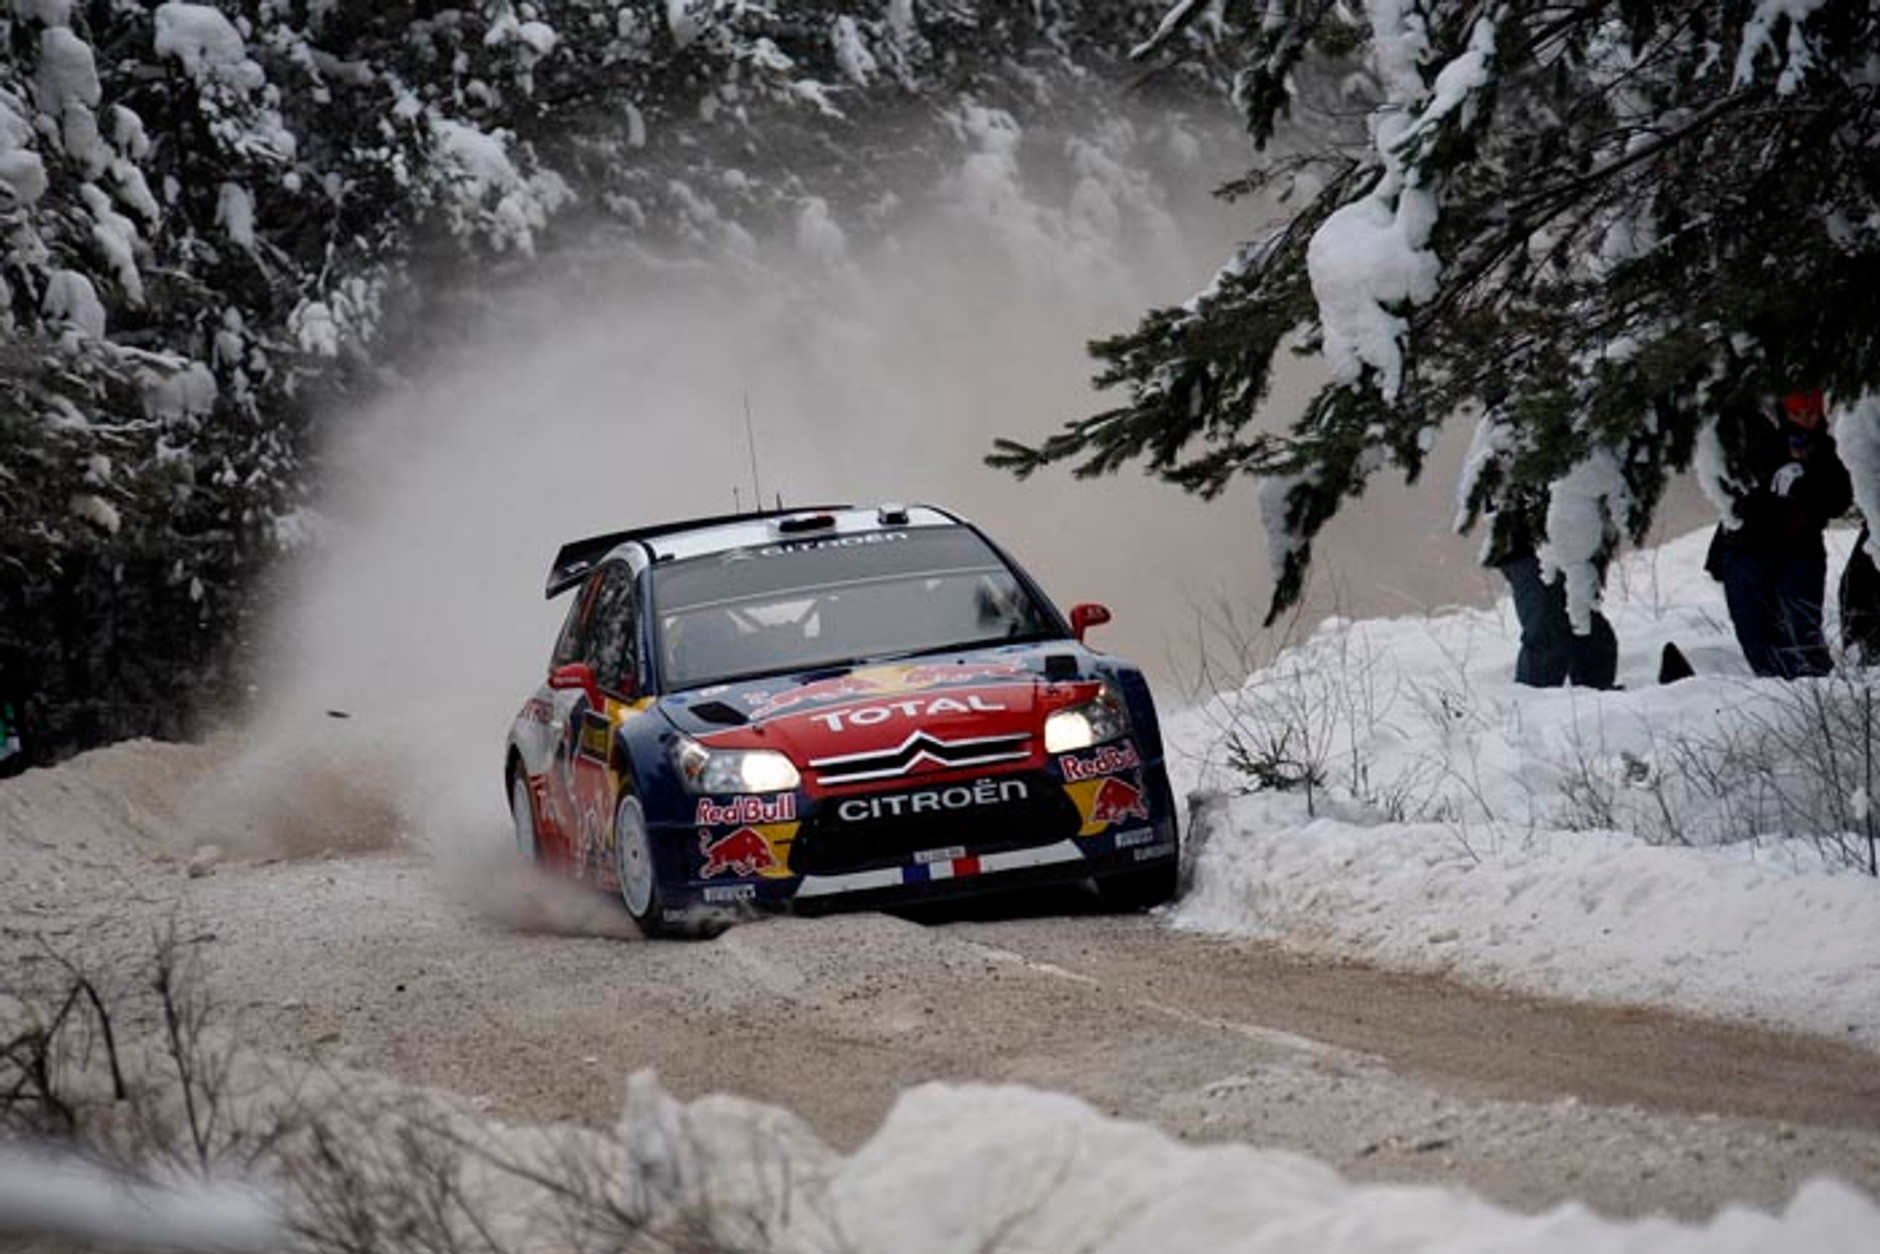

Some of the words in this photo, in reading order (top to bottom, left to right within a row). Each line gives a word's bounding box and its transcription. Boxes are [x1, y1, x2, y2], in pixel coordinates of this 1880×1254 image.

[810, 695, 1006, 731] TOTAL
[1058, 747, 1111, 782] Red
[695, 796, 742, 825] Red
[742, 792, 796, 823] Bull
